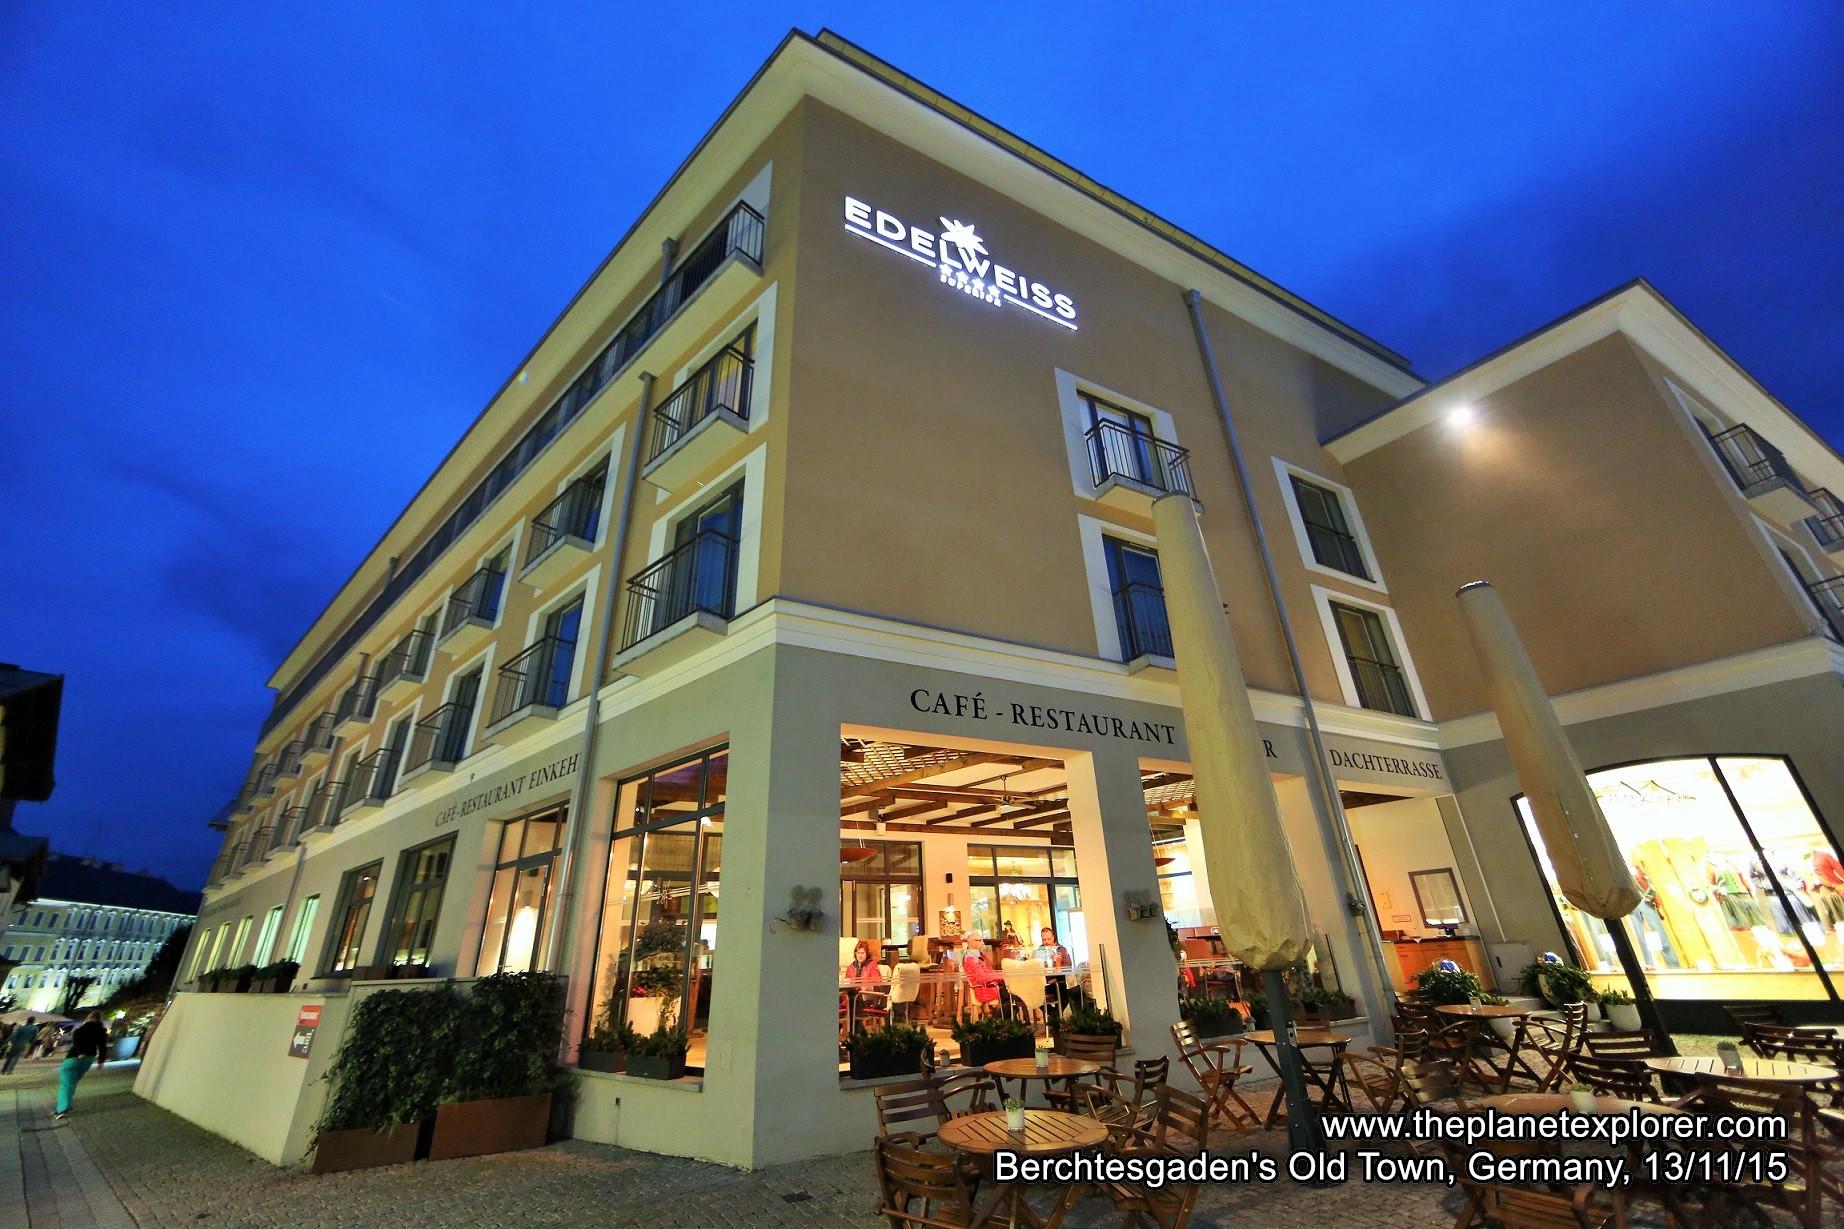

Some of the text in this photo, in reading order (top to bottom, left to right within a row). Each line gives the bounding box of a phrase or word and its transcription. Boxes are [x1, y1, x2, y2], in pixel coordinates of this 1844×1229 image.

[845, 196, 1077, 319] EDELWEISS
[910, 688, 988, 721] CAFÉ
[1010, 703, 1175, 745] RESTAURANT
[528, 752, 583, 790] EINKEH
[1330, 749, 1443, 780] DACHTERRASSE
